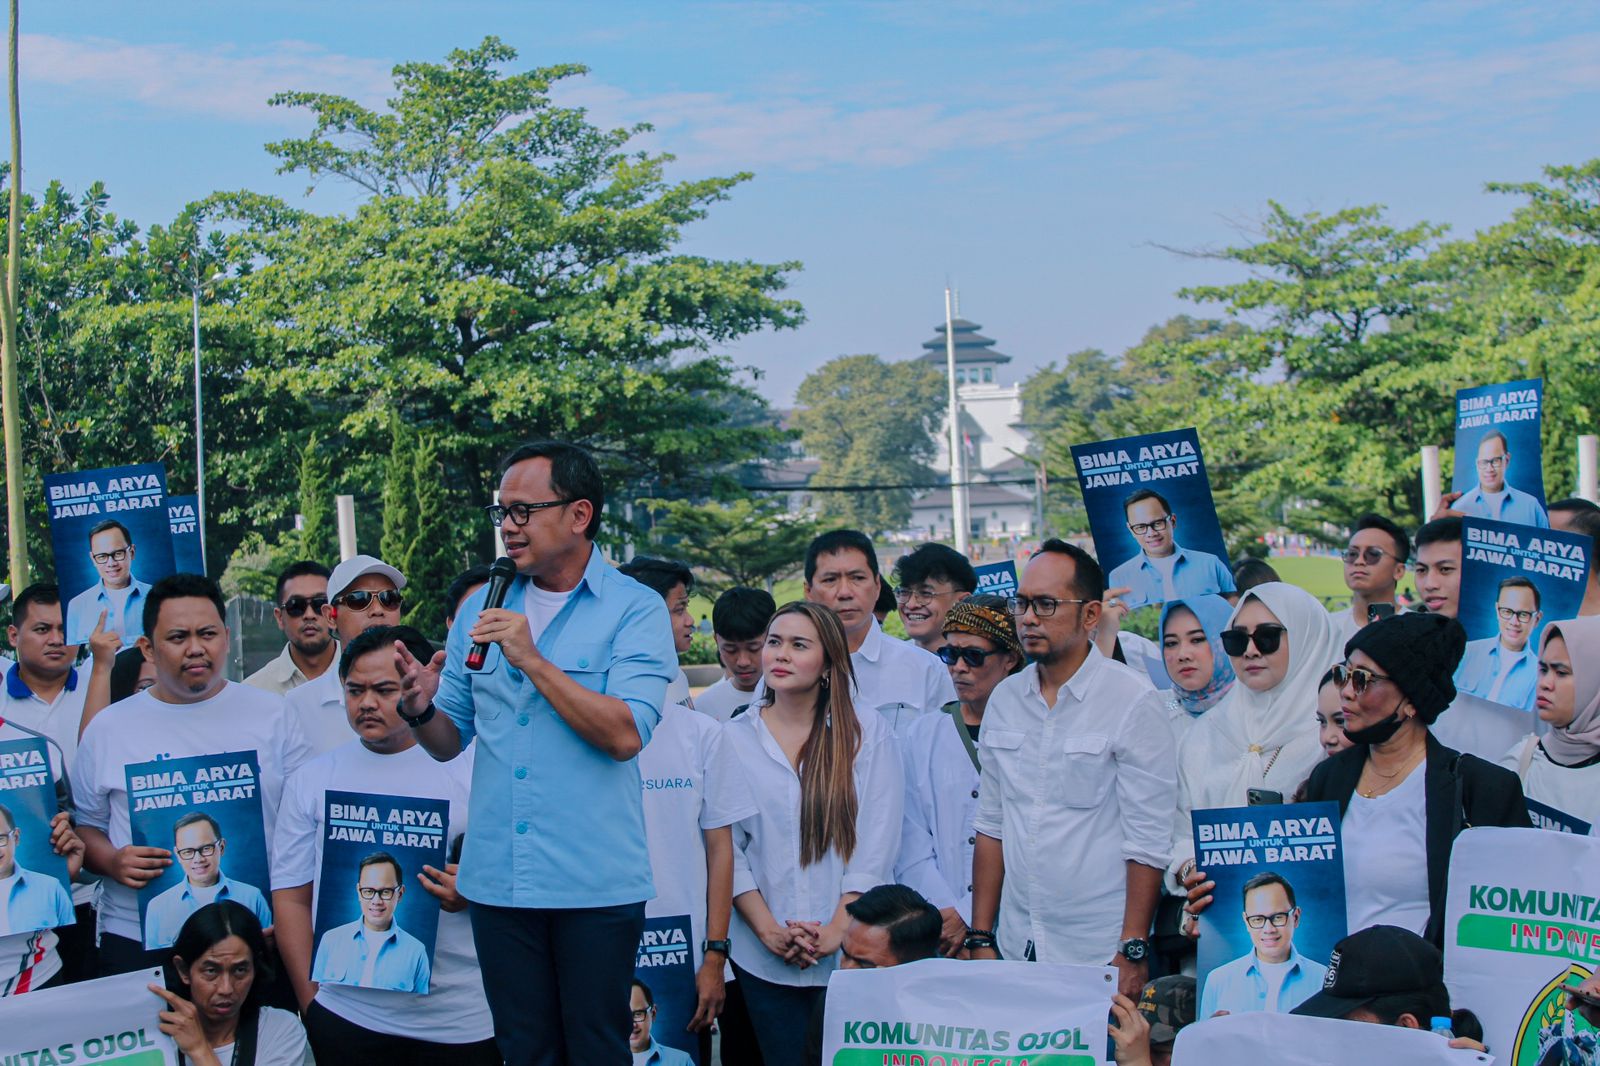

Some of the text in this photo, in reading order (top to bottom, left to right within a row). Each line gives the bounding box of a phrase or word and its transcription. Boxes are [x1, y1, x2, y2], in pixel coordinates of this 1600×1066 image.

[1460, 395, 1493, 412] BIMA
[1497, 389, 1538, 406] ARYA
[1459, 414, 1490, 430] JAWA
[1494, 408, 1538, 423] BARAT
[1078, 440, 1196, 469] BIMA ARYA
[1124, 461, 1154, 471] UNTUK
[1085, 461, 1200, 489] JAWA BARAT
[50, 474, 161, 500] BIMA ARYA
[92, 492, 121, 502] UNTUK
[53, 495, 163, 519] JAWA BARAT
[1467, 527, 1585, 562] BIMA ARYA
[1511, 548, 1541, 559] UNTUK
[1466, 548, 1584, 582] JAWA BARAT
[977, 570, 1014, 588] RYA
[0, 751, 45, 769] RYA
[0, 772, 48, 790] ARAT
[131, 763, 254, 791] BIMA ARYA
[178, 783, 210, 793] UNTUK
[134, 785, 255, 812] JAWA BARAT
[329, 803, 443, 828] BIMA ARYA
[371, 822, 400, 832] UNTUK
[328, 827, 443, 849] JAWA BARAT
[1198, 817, 1335, 842] BIMA ARYA
[1248, 838, 1285, 848] UNTUK
[1201, 844, 1337, 867] JAWA BARAT
[639, 928, 687, 946] RYA
[635, 950, 689, 968] ARAT
[82, 1028, 155, 1059] OJOL
[844, 1020, 1089, 1051] KOMUNITAS OJOL
